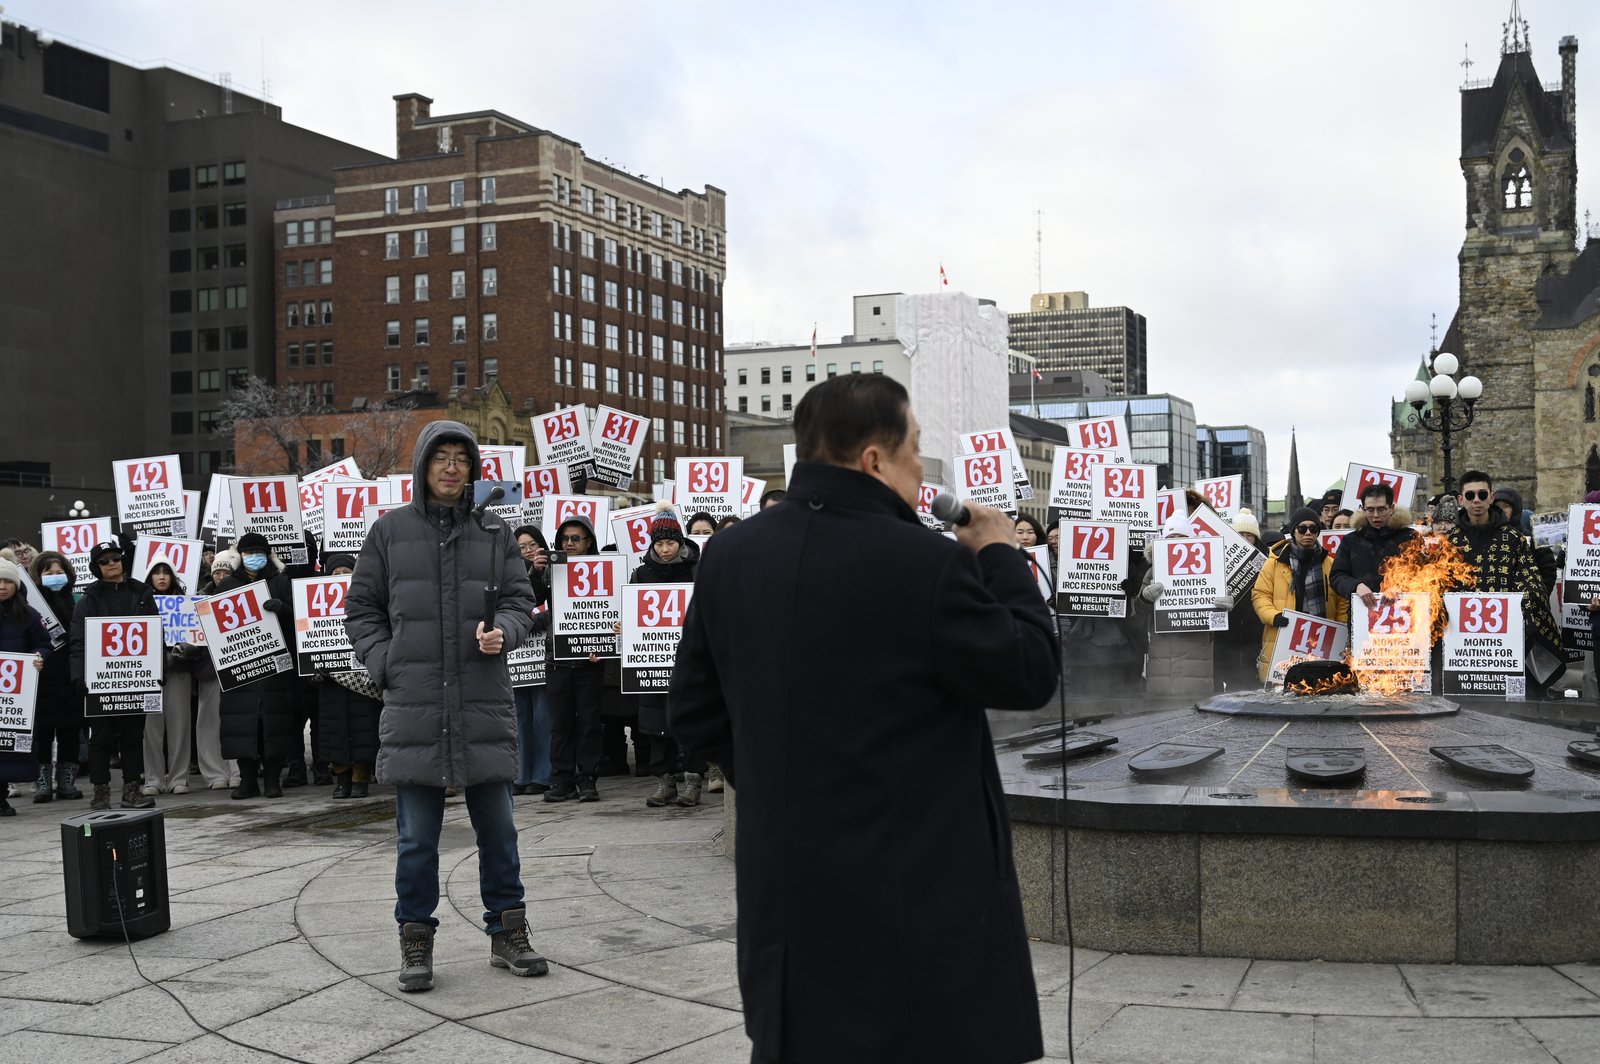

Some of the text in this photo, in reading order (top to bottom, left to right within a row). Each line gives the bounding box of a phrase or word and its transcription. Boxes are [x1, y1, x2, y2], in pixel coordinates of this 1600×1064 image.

[547, 414, 575, 443] 25
[607, 414, 632, 444] 31
[1084, 421, 1112, 449] 19
[552, 440, 578, 452] MONTHS
[601, 441, 627, 454] MONTHS
[547, 445, 586, 461] WAITING FOR
[593, 447, 618, 460] WAITING
[619, 454, 631, 463] FOR
[602, 456, 631, 471] RESPONSE
[969, 456, 997, 486] 63
[133, 463, 164, 490] 42
[597, 473, 618, 485] RESULTS
[692, 462, 725, 492] 39
[527, 469, 554, 498] 19
[1066, 482, 1091, 490] MONTH
[1108, 468, 1141, 498] 34
[971, 486, 999, 496] MONTHS
[1058, 490, 1088, 498] WAITING
[1206, 482, 1228, 508] 33
[135, 492, 166, 502] MONTHS
[250, 482, 281, 513] 11
[692, 496, 724, 504] MONTHS
[994, 494, 1007, 502] FOR
[1053, 497, 1068, 505] IRCC
[128, 500, 175, 511] WAITING FOR
[342, 488, 369, 518] 71
[1108, 501, 1140, 510] MONTHS
[124, 507, 180, 520] IRCC RESPONSE
[523, 509, 542, 517] WAITI
[684, 505, 733, 513] WAITING FOR
[1101, 509, 1132, 518] WAITING
[251, 516, 284, 524] MONTHS
[133, 520, 171, 531] NO TIMELINE
[244, 524, 294, 533] WAITING FOR
[341, 521, 364, 530] MONT
[61, 524, 94, 554] 30
[333, 530, 365, 539] WAITING
[329, 540, 346, 548] IRCC
[1078, 527, 1109, 559] 72
[1226, 543, 1240, 558] FOR
[1172, 543, 1206, 575] 23
[1076, 563, 1110, 571] MONTHS
[1067, 572, 1118, 581] WAITING FOR
[1570, 568, 1590, 577] IRCC
[572, 562, 608, 597] 31
[1172, 578, 1207, 587] MONTHS
[1062, 581, 1121, 591] IRCC RESPONSE
[1164, 587, 1216, 597] WAITING FOR
[1231, 588, 1240, 598] NO
[154, 596, 185, 612] TOP
[312, 582, 345, 617] 42
[1160, 597, 1215, 606] IRCC RESPONS
[572, 600, 609, 610] MONTHS
[642, 590, 681, 627] 34
[1082, 604, 1109, 612] RESULTS
[218, 592, 257, 630] 31
[564, 610, 619, 621] WAITING FOR
[1373, 599, 1410, 633] 25
[1464, 598, 1503, 633] 33
[313, 618, 345, 628] MONTHS
[559, 621, 616, 631] IRCC RESPON
[1182, 619, 1210, 627] RESULTS
[1566, 617, 1583, 626] IRCC
[105, 622, 143, 656] 36
[226, 626, 261, 643] MONTHS
[306, 629, 339, 639] WAITING
[642, 632, 681, 641] MONTHS
[220, 632, 273, 655] WAITING FOR
[302, 638, 350, 649] IRCC RESPON
[568, 636, 616, 645] NO TIMELINES
[1295, 621, 1327, 658] 11
[1464, 638, 1503, 647] MONTHS
[583, 645, 613, 653] RESULTS
[632, 643, 670, 652] WAITING
[218, 640, 280, 666] IRCC RESPONSE
[311, 652, 351, 662] NO TIMELINE
[1454, 649, 1513, 657] WAITING FOR
[627, 654, 676, 663] IRCC RESPO
[1449, 659, 1518, 668] IRCC RESPONSE
[106, 660, 142, 669] MONTHS
[325, 659, 352, 669] RESULTS
[516, 663, 546, 673] TIMELINE
[97, 670, 151, 680] WAITING FOR
[231, 666, 242, 676] NO
[236, 664, 276, 682] NO RESULTS
[636, 670, 647, 678] NO
[91, 680, 156, 690] IRCC RESPONSE
[640, 679, 650, 687] NO
[1461, 682, 1506, 691] NO RESULTS
[111, 694, 144, 703] TIMELINE
[5, 707, 23, 716] FOR
[103, 702, 144, 711] NO RESULTS
